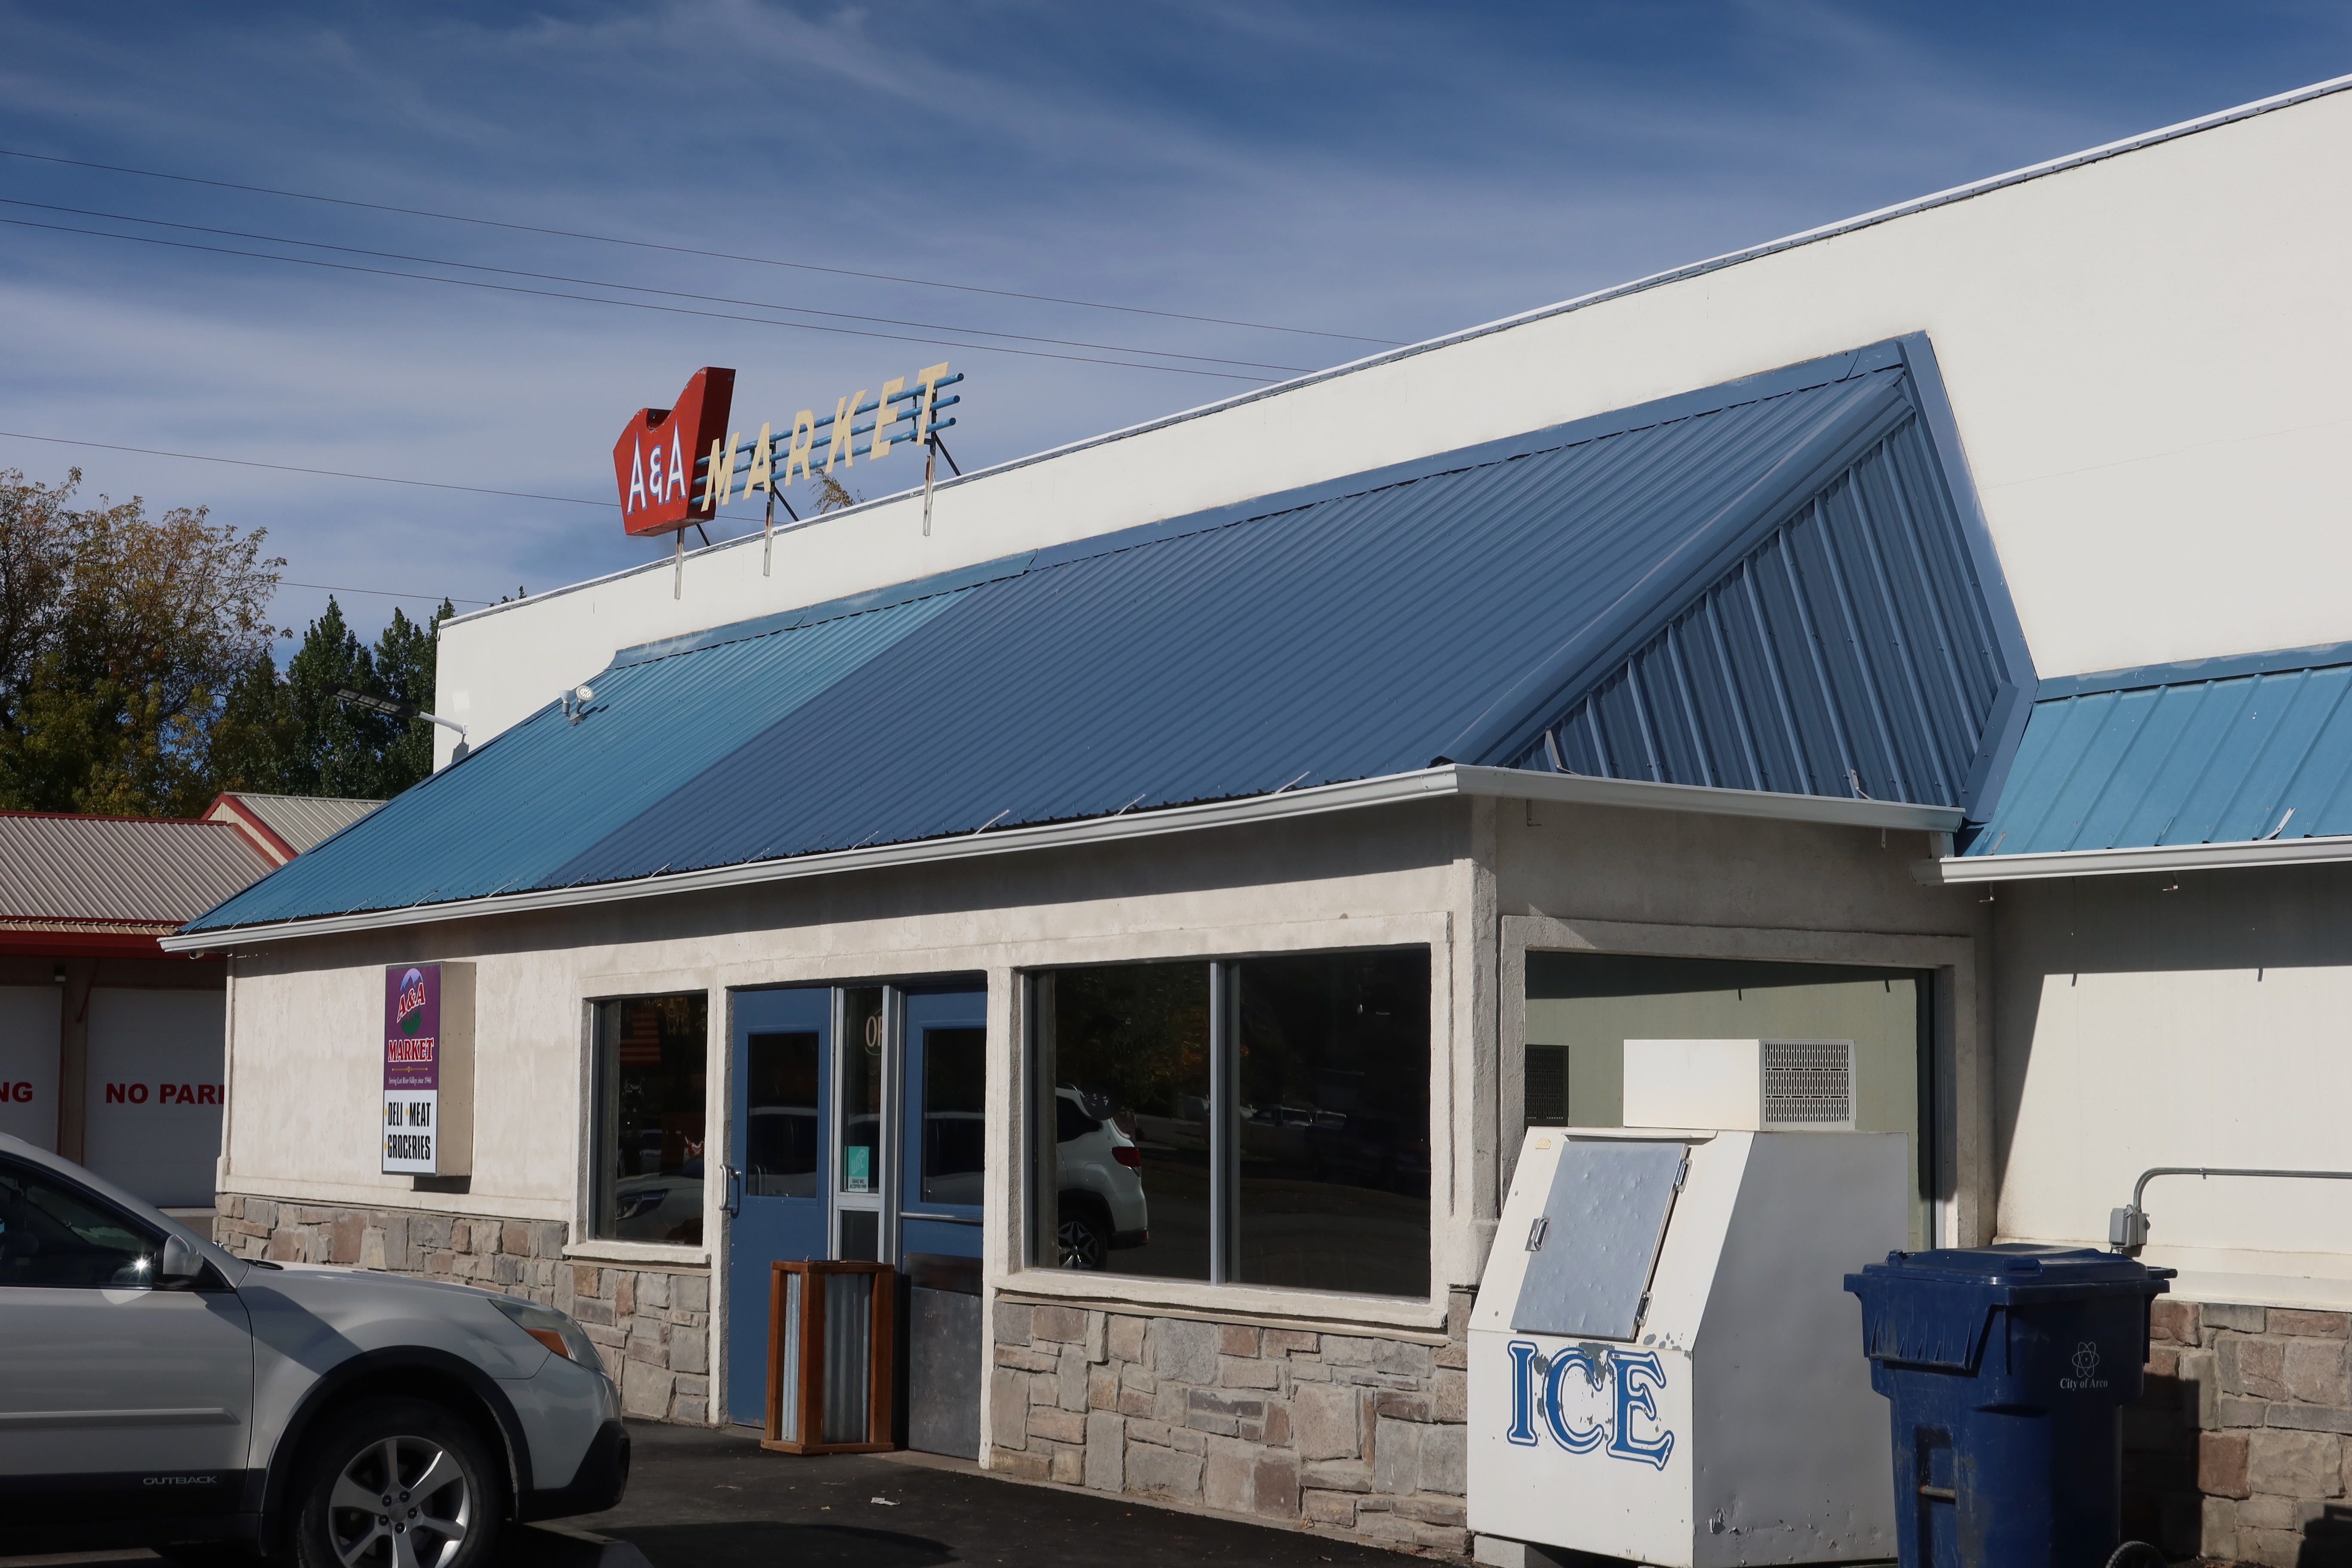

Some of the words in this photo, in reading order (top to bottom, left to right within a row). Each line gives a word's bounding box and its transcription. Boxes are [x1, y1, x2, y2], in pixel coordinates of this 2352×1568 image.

[618, 418, 686, 515] A&A
[700, 362, 949, 512] MARKET
[396, 982, 426, 1023] A&A
[388, 1037, 434, 1063] MARKET
[106, 1083, 148, 1104] NO
[388, 1102, 403, 1126] DELI
[409, 1102, 431, 1127] MEAT
[388, 1134, 430, 1160] GROCERIES
[2060, 1378, 2078, 1391] City
[2079, 1378, 2089, 1388] of
[2090, 1378, 2108, 1388] Arco
[1507, 1340, 1675, 1471] ICE
[143, 1476, 217, 1485] OUTBACK
